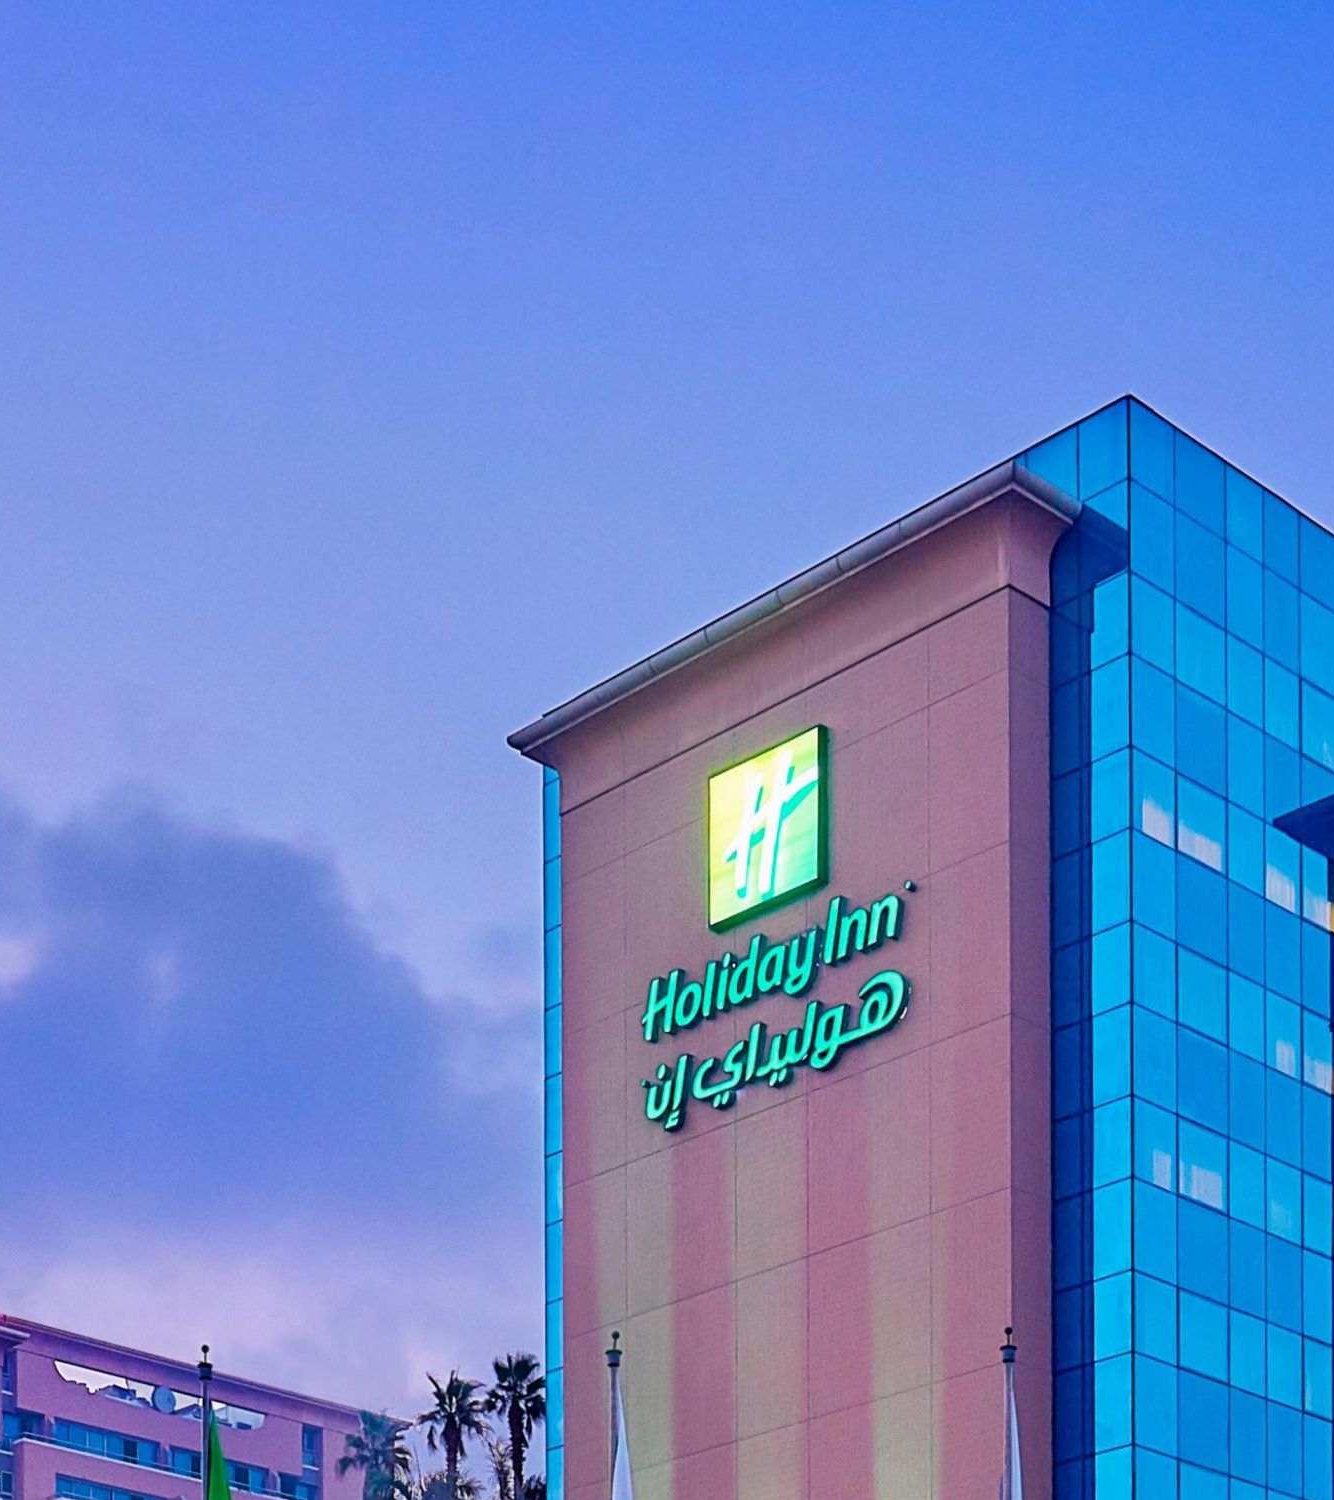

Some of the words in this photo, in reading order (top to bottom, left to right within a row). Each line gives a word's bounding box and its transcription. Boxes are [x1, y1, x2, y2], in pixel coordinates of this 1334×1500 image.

[641, 933, 819, 1042] Holiday
[819, 896, 904, 968] Inn
[693, 969, 908, 1110] هوليداي
